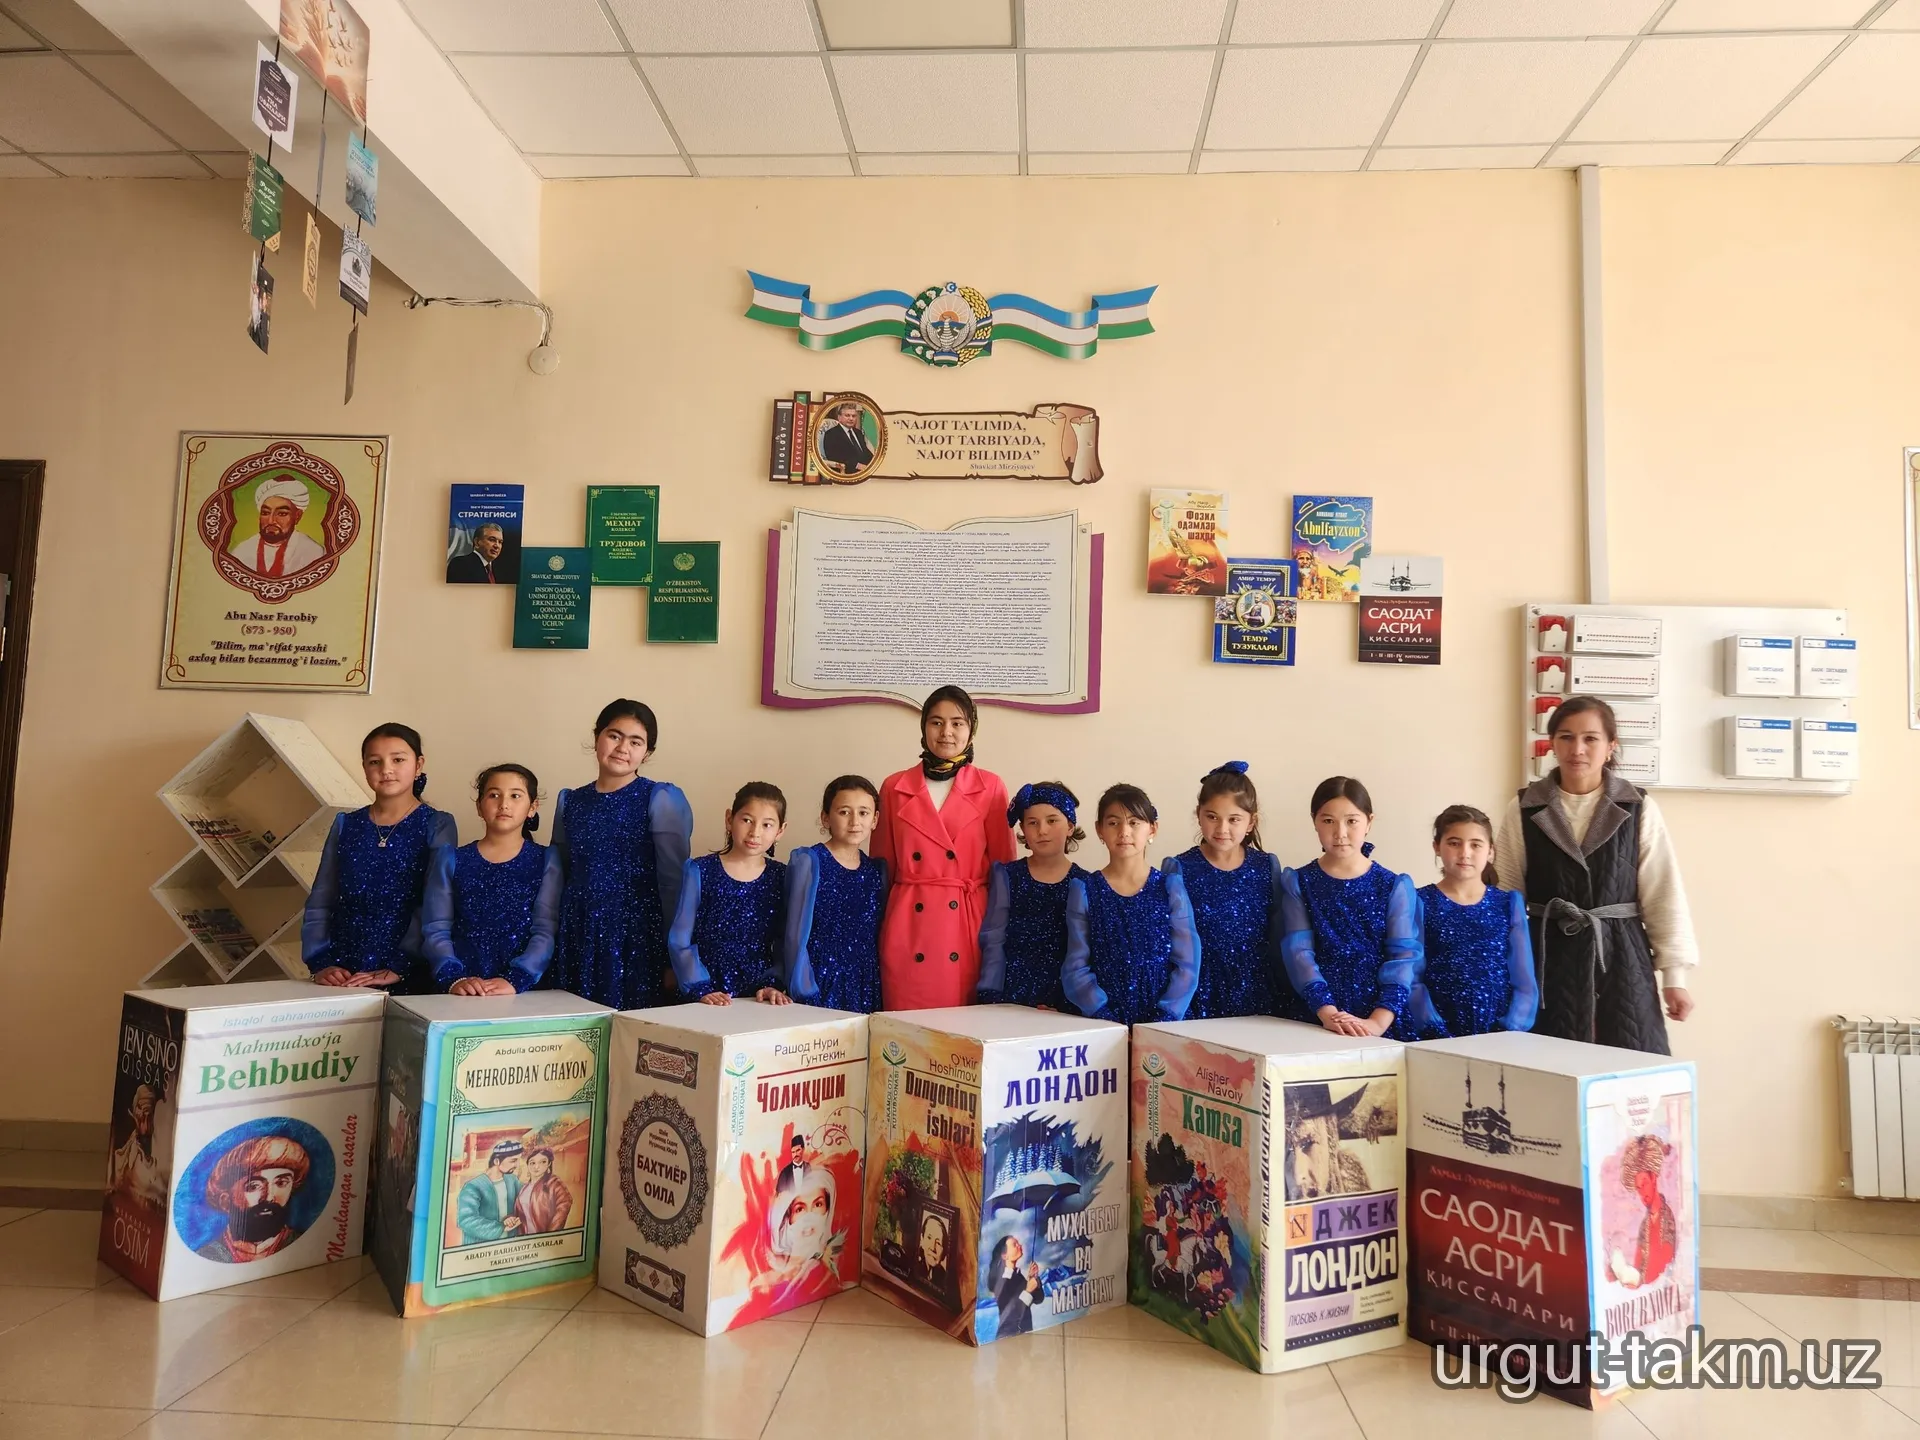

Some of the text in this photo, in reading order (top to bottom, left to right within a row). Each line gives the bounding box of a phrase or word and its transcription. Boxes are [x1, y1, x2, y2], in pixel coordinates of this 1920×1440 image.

[796, 409, 804, 466] PSYCHOLOGY
[893, 420, 948, 430] “NAJOT
[778, 427, 787, 469] BIOLOGY
[907, 435, 1046, 447] NAJOT TARBIYADA,
[917, 449, 1040, 460] NAJOT BILIMDA”
[1178, 520, 1216, 531] одамлар
[1186, 511, 1215, 521] Фозил
[1302, 521, 1360, 537] Abulfayzxon
[225, 611, 318, 624] Abu Nasr Farobiy
[1368, 608, 1434, 621] САОДАТ
[241, 624, 265, 636] (873
[273, 625, 297, 637] 950)
[1378, 622, 1421, 634] АСРИ
[188, 653, 216, 665] axloq
[219, 653, 245, 664] bilan
[294, 643, 327, 655] yaxshi
[1232, 643, 1278, 651] ТУЗУКЛАРИ
[123, 1024, 178, 1072] IBN SINO
[495, 1044, 563, 1056] Abdulla QODIRIY
[774, 1038, 839, 1057] Рашод Нури
[801, 1050, 846, 1066] Гунтекин
[1037, 1044, 1088, 1072] ЖЕК
[197, 1050, 360, 1095] Behbudiy
[465, 1059, 588, 1089] MEHROBDAN CHAYON
[929, 1058, 978, 1082] Hoshimov
[1196, 1066, 1230, 1085] Alisher
[905, 1070, 978, 1119] Dunyoning
[1003, 1068, 1117, 1109] ЛОНДОН
[1207, 1081, 1243, 1104] Navoiy
[738, 1080, 746, 1136] KUTUBXONASI
[341, 1112, 358, 1167] asarlar
[927, 1109, 975, 1148] ishlari
[637, 1154, 687, 1185] БАХТИЁР
[644, 1181, 675, 1207] ОИЛА
[1315, 1199, 1397, 1241] ДЖЕК
[1419, 1188, 1574, 1256] САОДАТ
[113, 1217, 150, 1269] OSIM
[464, 1251, 492, 1261] ABADIY
[532, 1239, 564, 1249] ASARLAR
[515, 1252, 539, 1262] ROMAN
[1075, 1245, 1092, 1273] ВА
[1288, 1236, 1397, 1296] ЛОНДОН
[1444, 1235, 1544, 1295] АСРИ
[1052, 1275, 1115, 1315] МАТОНАТ
[1426, 1268, 1575, 1333] ҚИССАЛАРИ
[1288, 1304, 1350, 1327] ЛЮБОВЬ К ЖИЗНИ
[1605, 1284, 1681, 1340] BOBURNOMA
